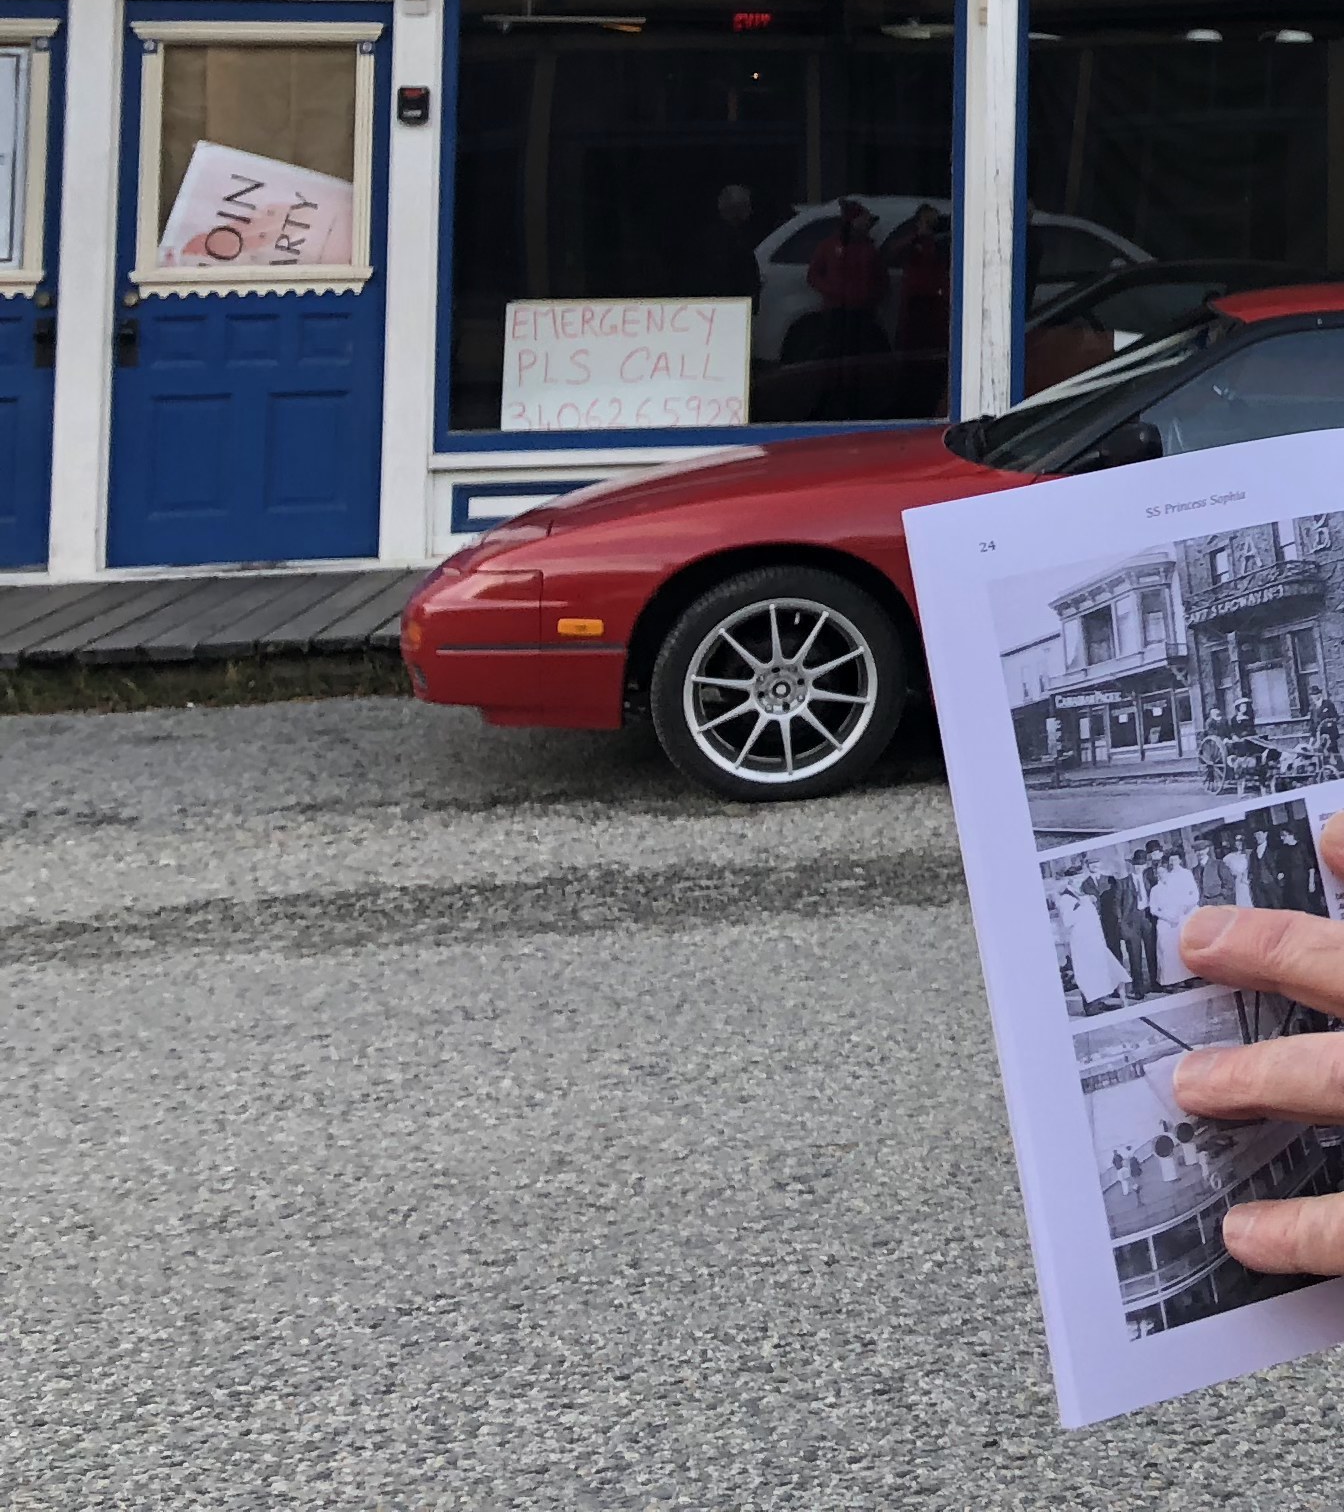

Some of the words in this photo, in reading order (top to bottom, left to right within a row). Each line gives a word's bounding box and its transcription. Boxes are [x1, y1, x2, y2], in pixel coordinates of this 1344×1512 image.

[199, 173, 268, 266] OIN
[512, 304, 717, 345] EMERGENCY
[518, 348, 593, 388] PLS
[619, 346, 727, 384] CALL
[1145, 506, 1161, 519] SS
[1165, 498, 1207, 515] Princess
[1210, 489, 1246, 505] Sophia
[978, 540, 996, 553] 24
